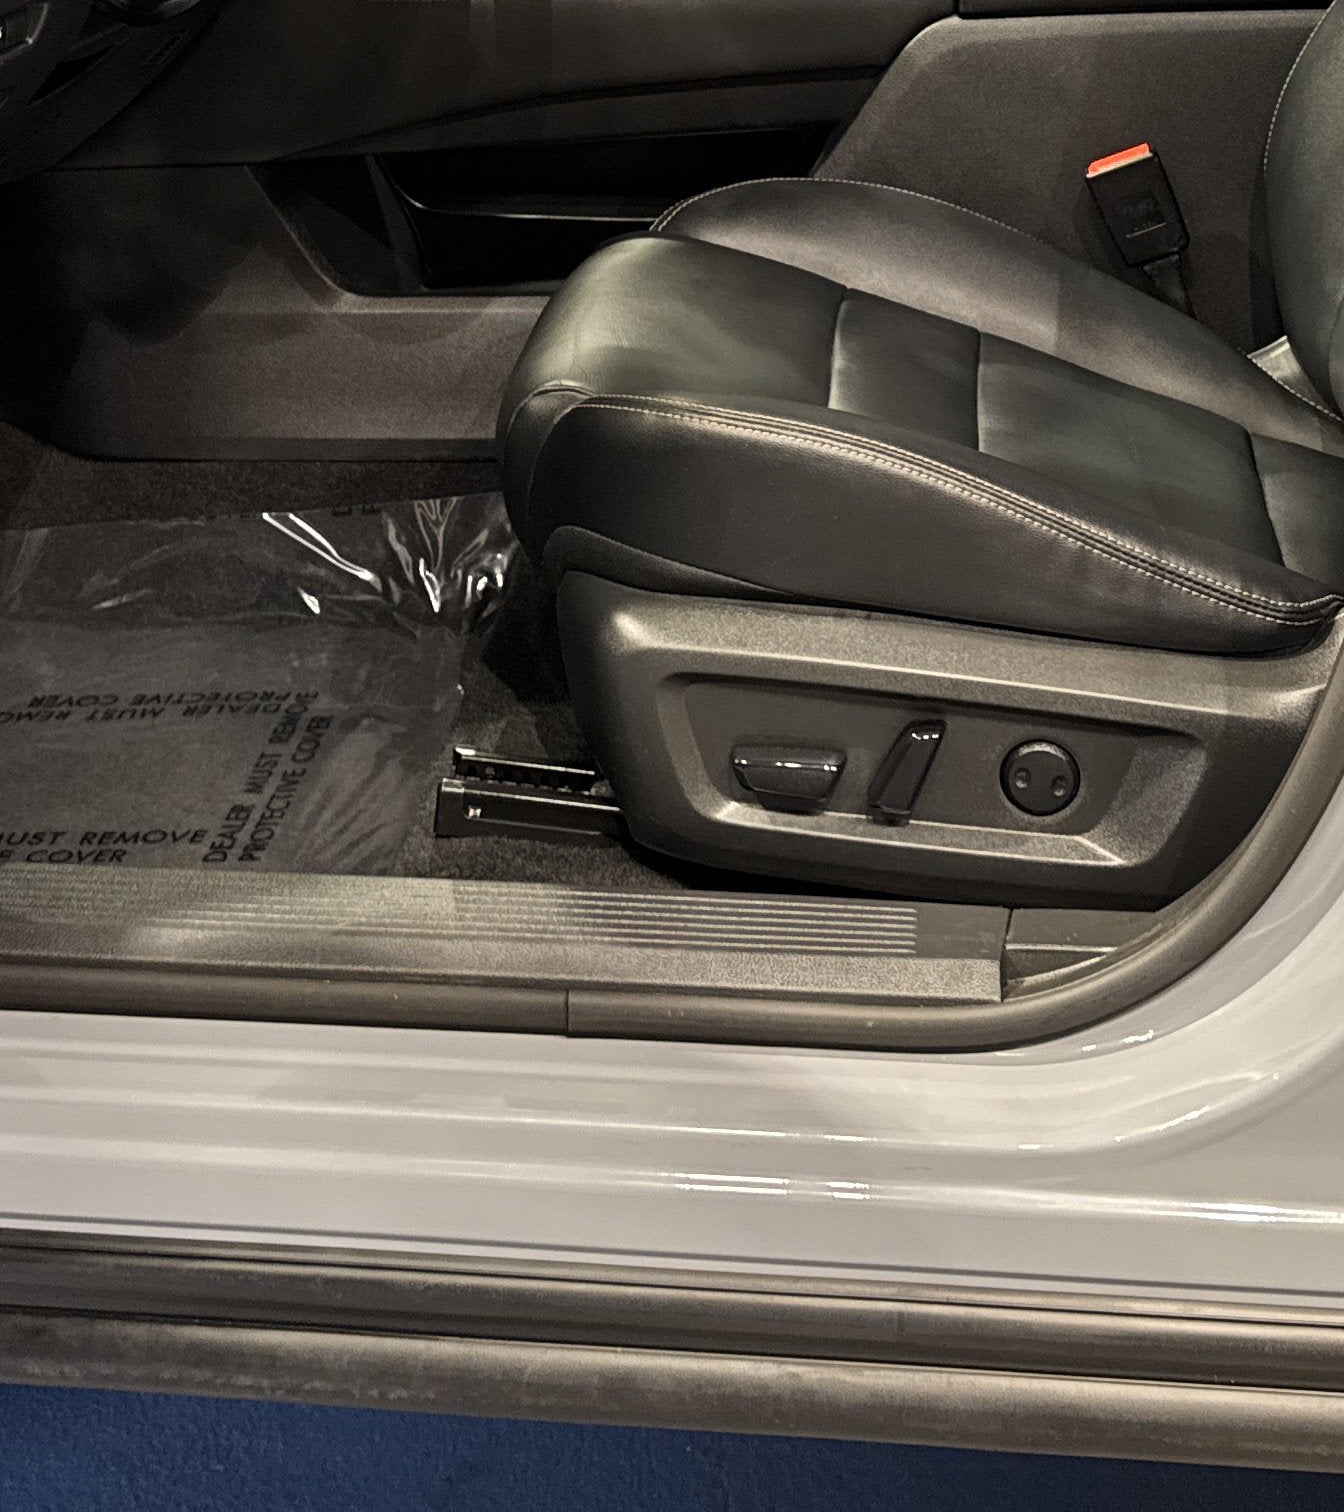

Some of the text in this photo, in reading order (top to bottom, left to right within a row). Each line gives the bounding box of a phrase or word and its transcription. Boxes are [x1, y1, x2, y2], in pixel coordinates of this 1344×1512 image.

[29, 690, 291, 708] PROTECTIVE COVER
[85, 707, 165, 721] MUST
[183, 703, 282, 717] DEALER
[238, 714, 334, 861] PROTECTIVE COVER
[202, 804, 256, 863] DEALER
[243, 751, 283, 794] MUST
[79, 829, 209, 846] REMOVE
[26, 849, 128, 863] COVER
